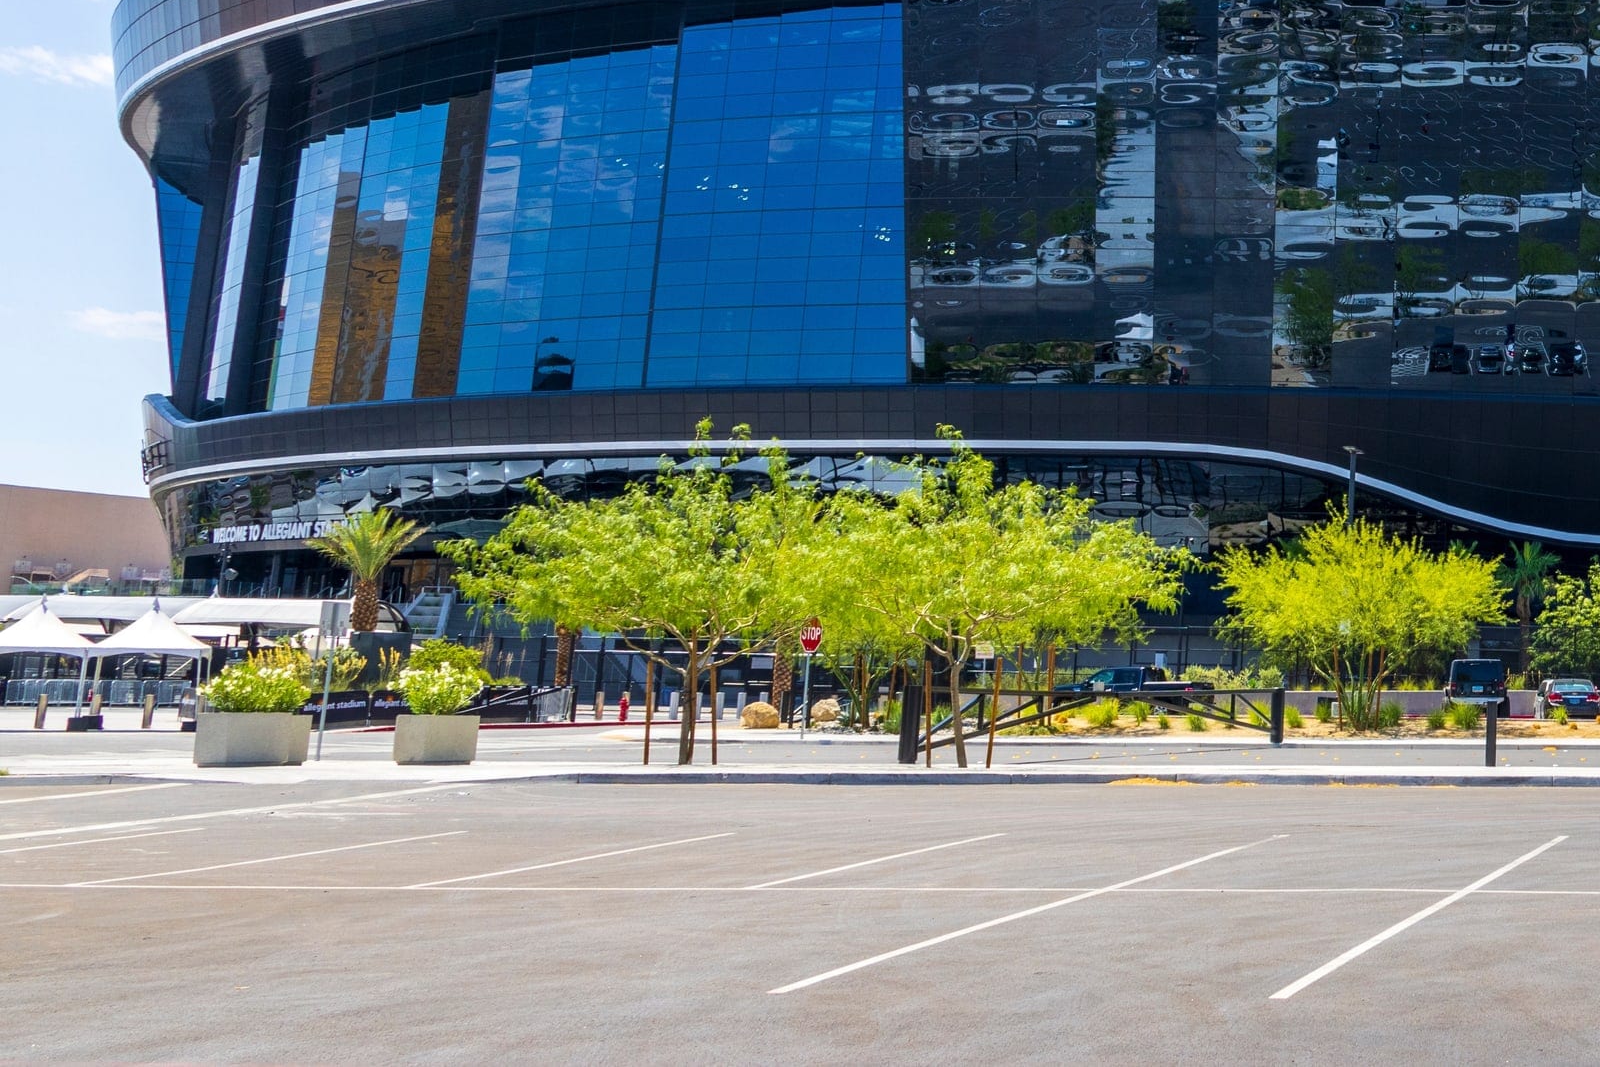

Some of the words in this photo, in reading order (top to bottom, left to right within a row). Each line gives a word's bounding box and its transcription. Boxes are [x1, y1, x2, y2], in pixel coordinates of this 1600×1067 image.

[213, 525, 247, 544] WELCOME
[249, 524, 260, 542] TO
[261, 521, 312, 541] ALLEGIANT
[801, 626, 821, 640] STOP
[336, 699, 366, 709] stadium
